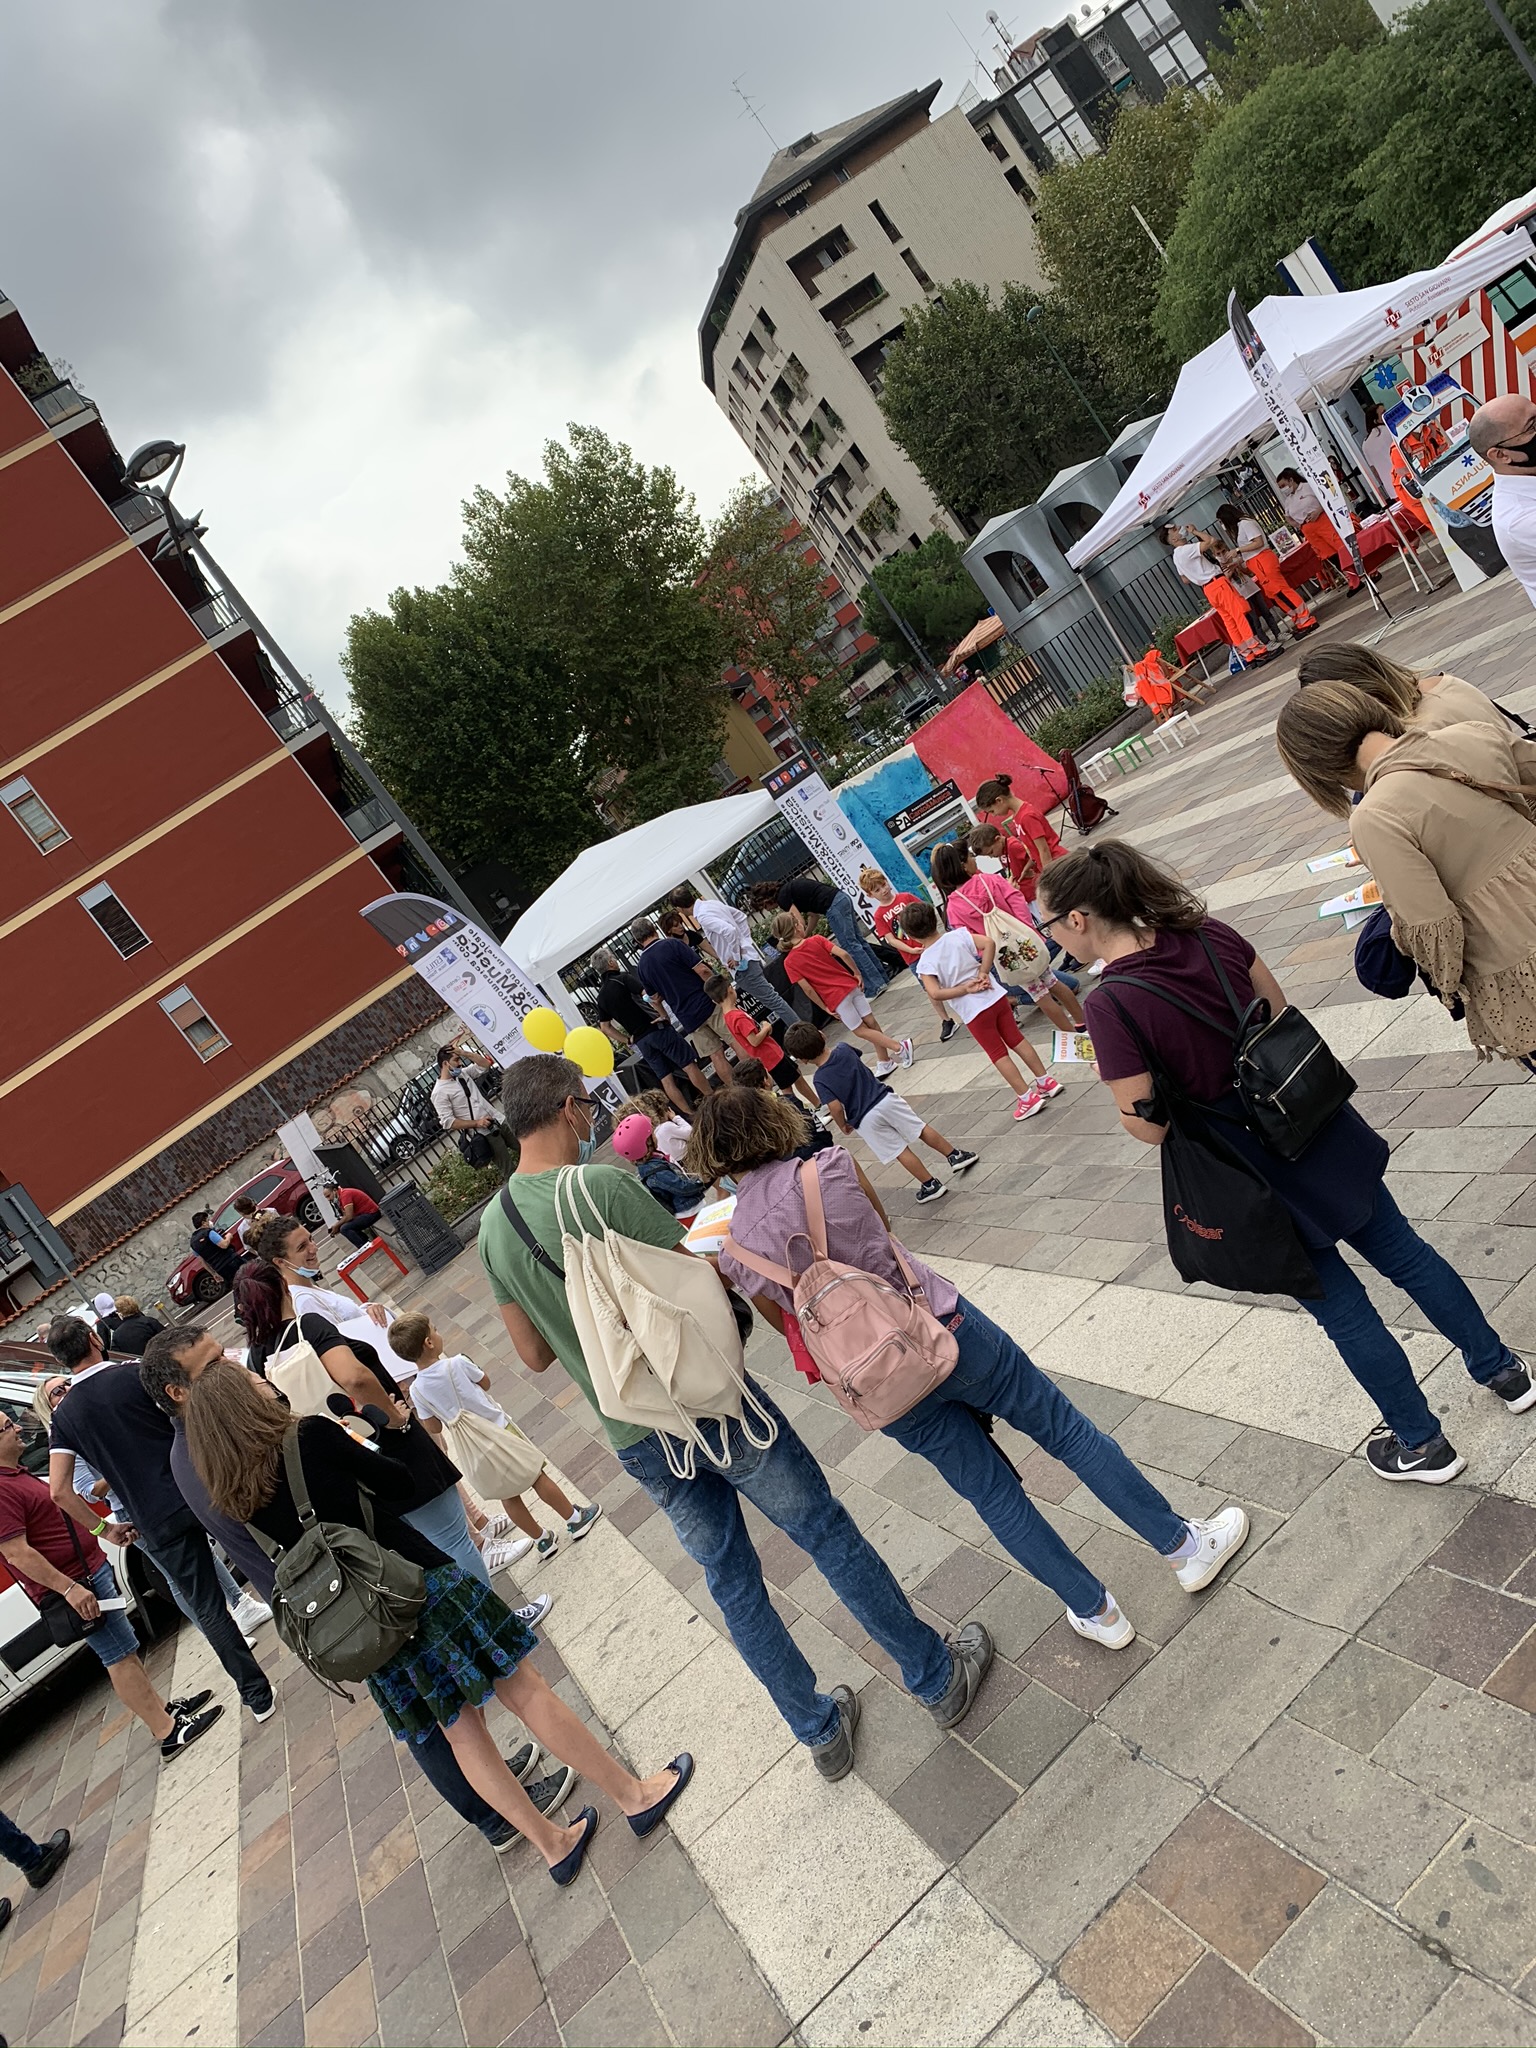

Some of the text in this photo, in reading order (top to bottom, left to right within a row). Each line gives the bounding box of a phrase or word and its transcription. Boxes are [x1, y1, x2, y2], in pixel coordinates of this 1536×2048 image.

[785, 796, 858, 898] Canto&Musica
[857, 892, 875, 926] SA
[882, 902, 907, 923] NASA
